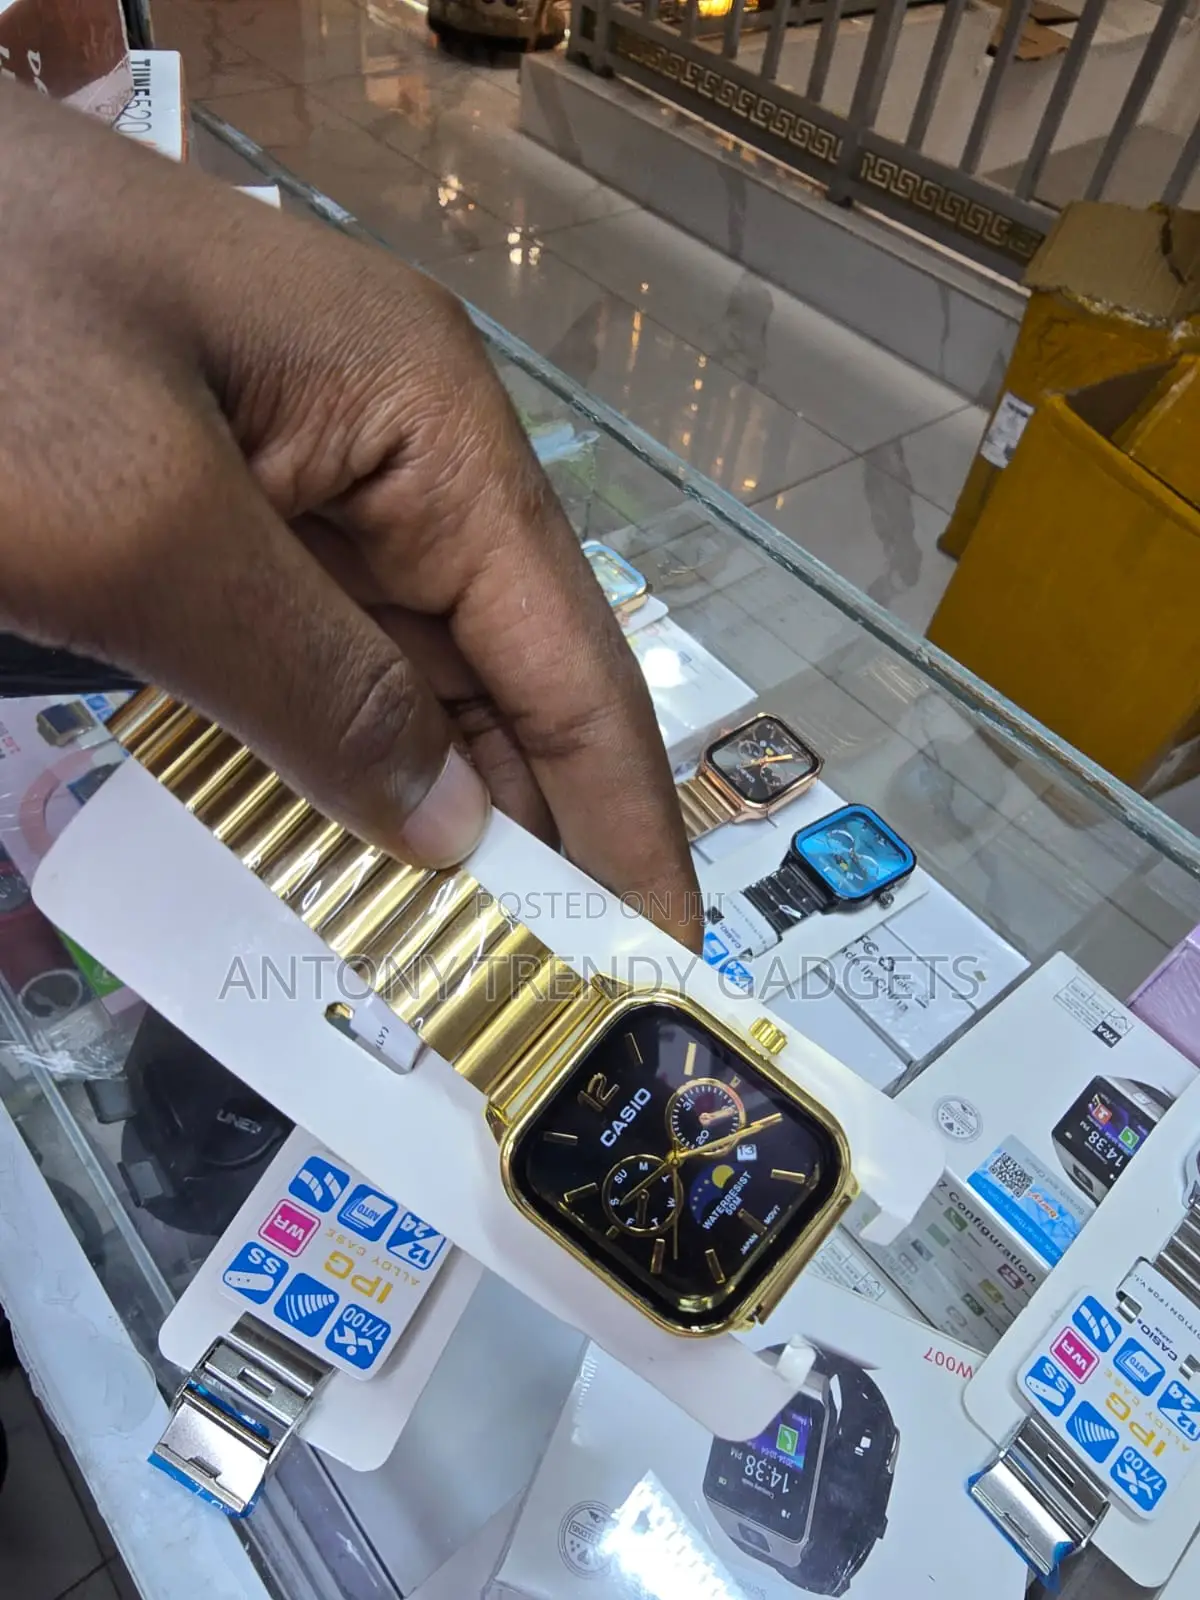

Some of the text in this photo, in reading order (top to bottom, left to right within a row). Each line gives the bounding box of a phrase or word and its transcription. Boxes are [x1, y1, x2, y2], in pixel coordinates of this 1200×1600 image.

[1097, 1025, 1118, 1044] TRA
[577, 1072, 620, 1112] 12
[600, 1088, 651, 1147] CASIO
[1088, 1131, 1124, 1167] 14:38
[614, 1169, 628, 1184] SU
[274, 1215, 305, 1241] WR
[356, 1204, 381, 1222] AUTO
[949, 1191, 1036, 1283] Configuration
[247, 1247, 281, 1273] SS
[408, 1243, 432, 1265] 12
[324, 1250, 394, 1304] IPG
[342, 1306, 387, 1341] 1/100
[924, 1347, 973, 1379] W007
[1061, 1338, 1088, 1371] WR
[1129, 1356, 1150, 1378] AUTO
[1042, 1362, 1070, 1393] SS
[1168, 1383, 1196, 1410] 24
[1105, 1391, 1166, 1457] IPG
[1177, 1411, 1200, 1437] 12
[730, 1446, 790, 1494] 14:38 PM
[1123, 1449, 1163, 1492] 1/100
